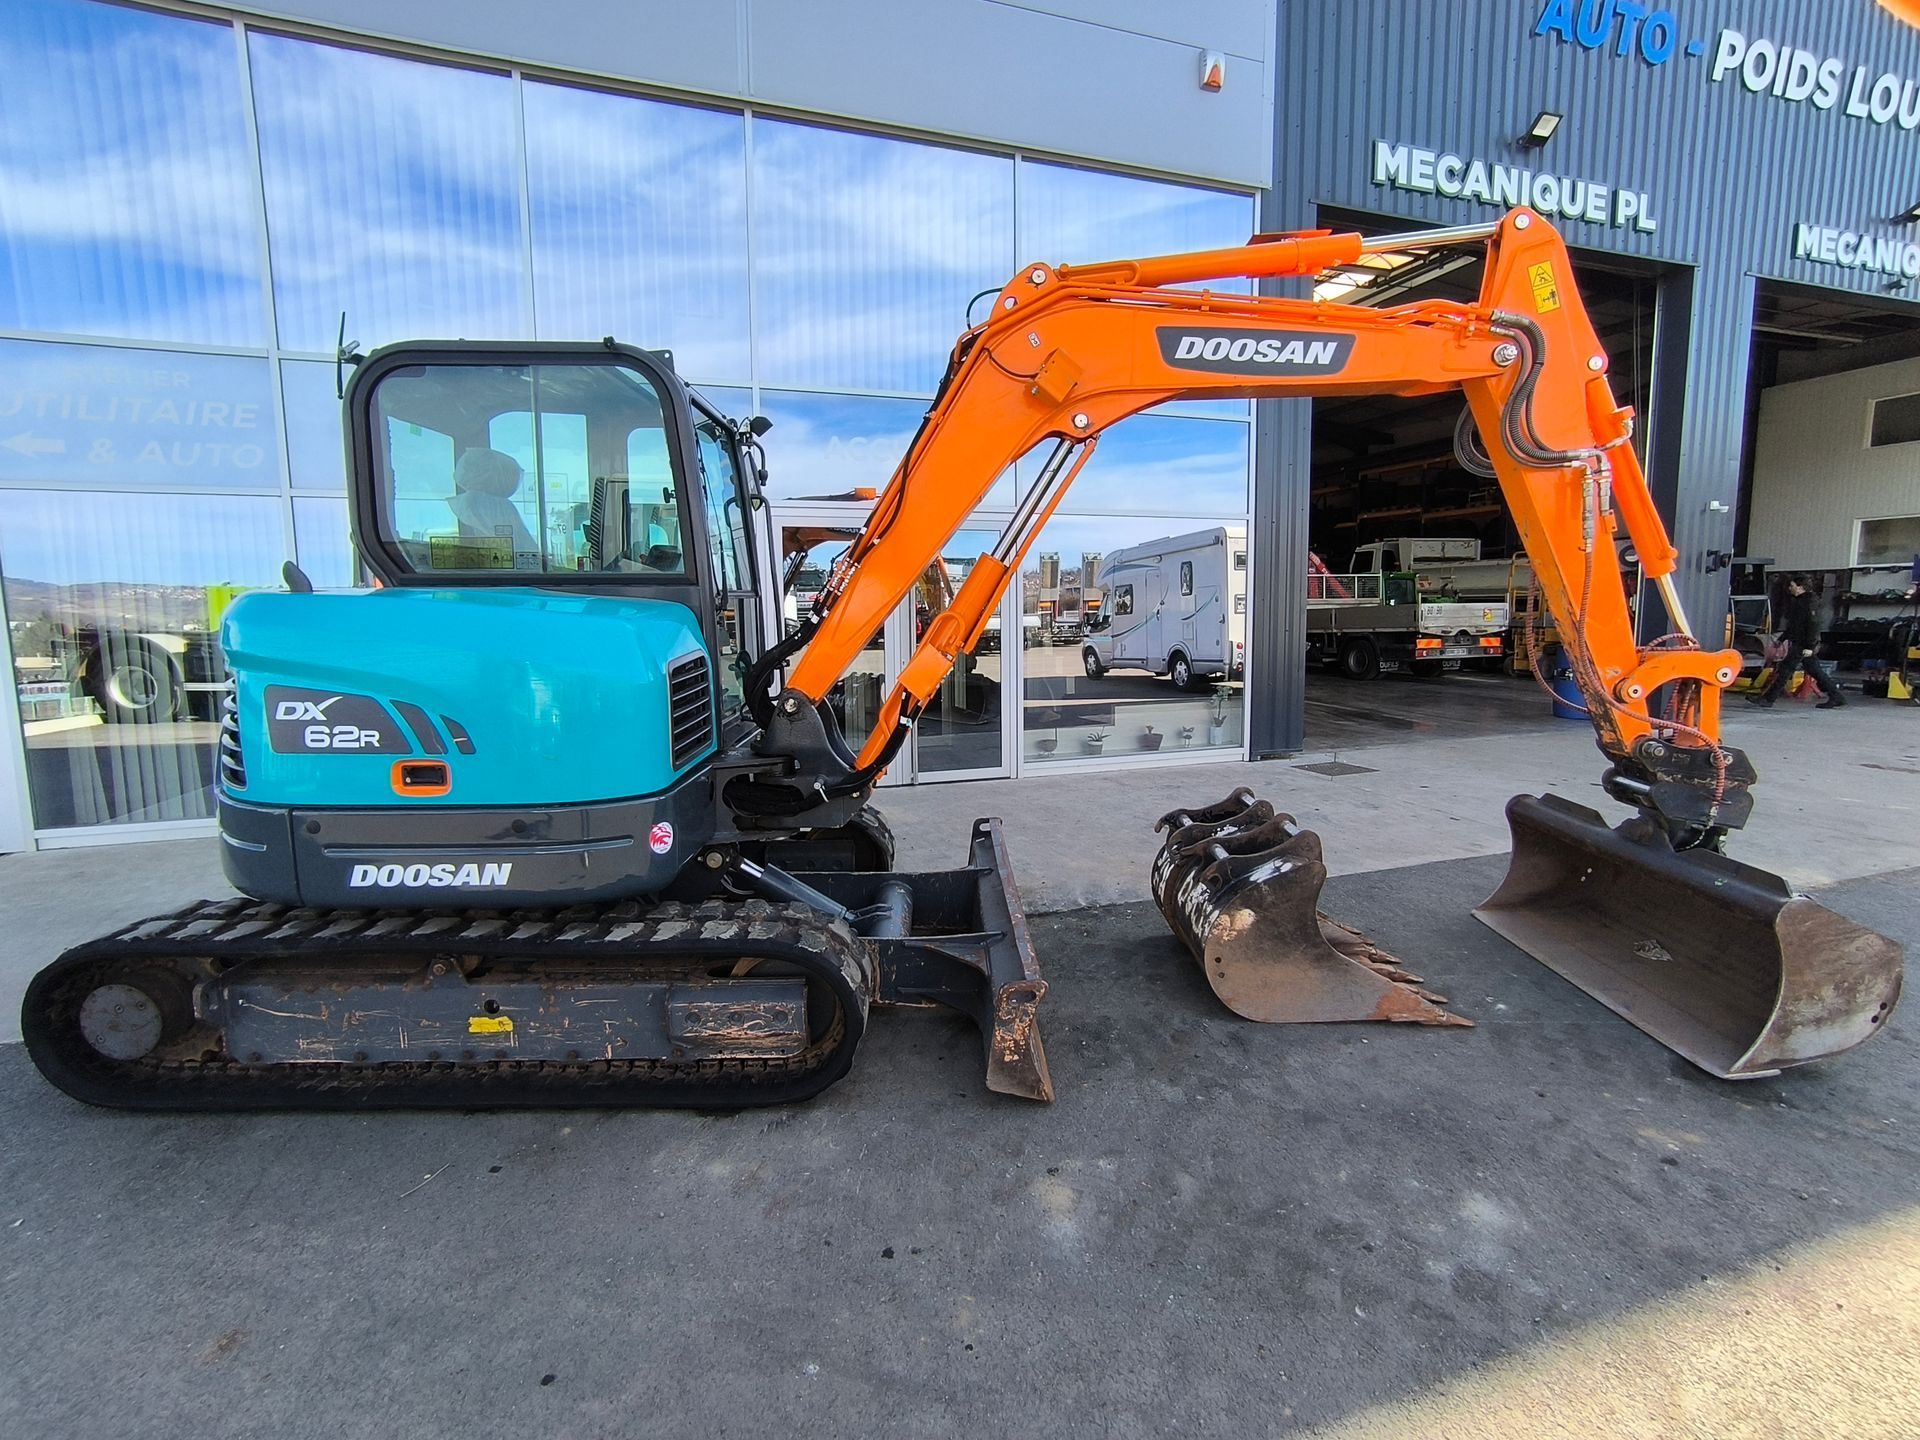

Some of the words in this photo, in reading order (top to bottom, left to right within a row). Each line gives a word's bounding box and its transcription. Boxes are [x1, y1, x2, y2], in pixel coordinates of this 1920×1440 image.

[1535, 0, 1677, 64] AUTO
[1712, 28, 1843, 109] POIDS
[1846, 65, 1920, 129] LOU
[1374, 141, 1609, 222] MECANIQUE
[1616, 189, 1658, 231] PL
[1795, 222, 1920, 279] MECANIQ
[1174, 336, 1338, 365] DOOSAN
[88, 437, 117, 465] &
[136, 439, 265, 469] AUTO
[275, 696, 343, 721] DX
[304, 725, 380, 748] 62R
[350, 863, 512, 888] DOOSAN
